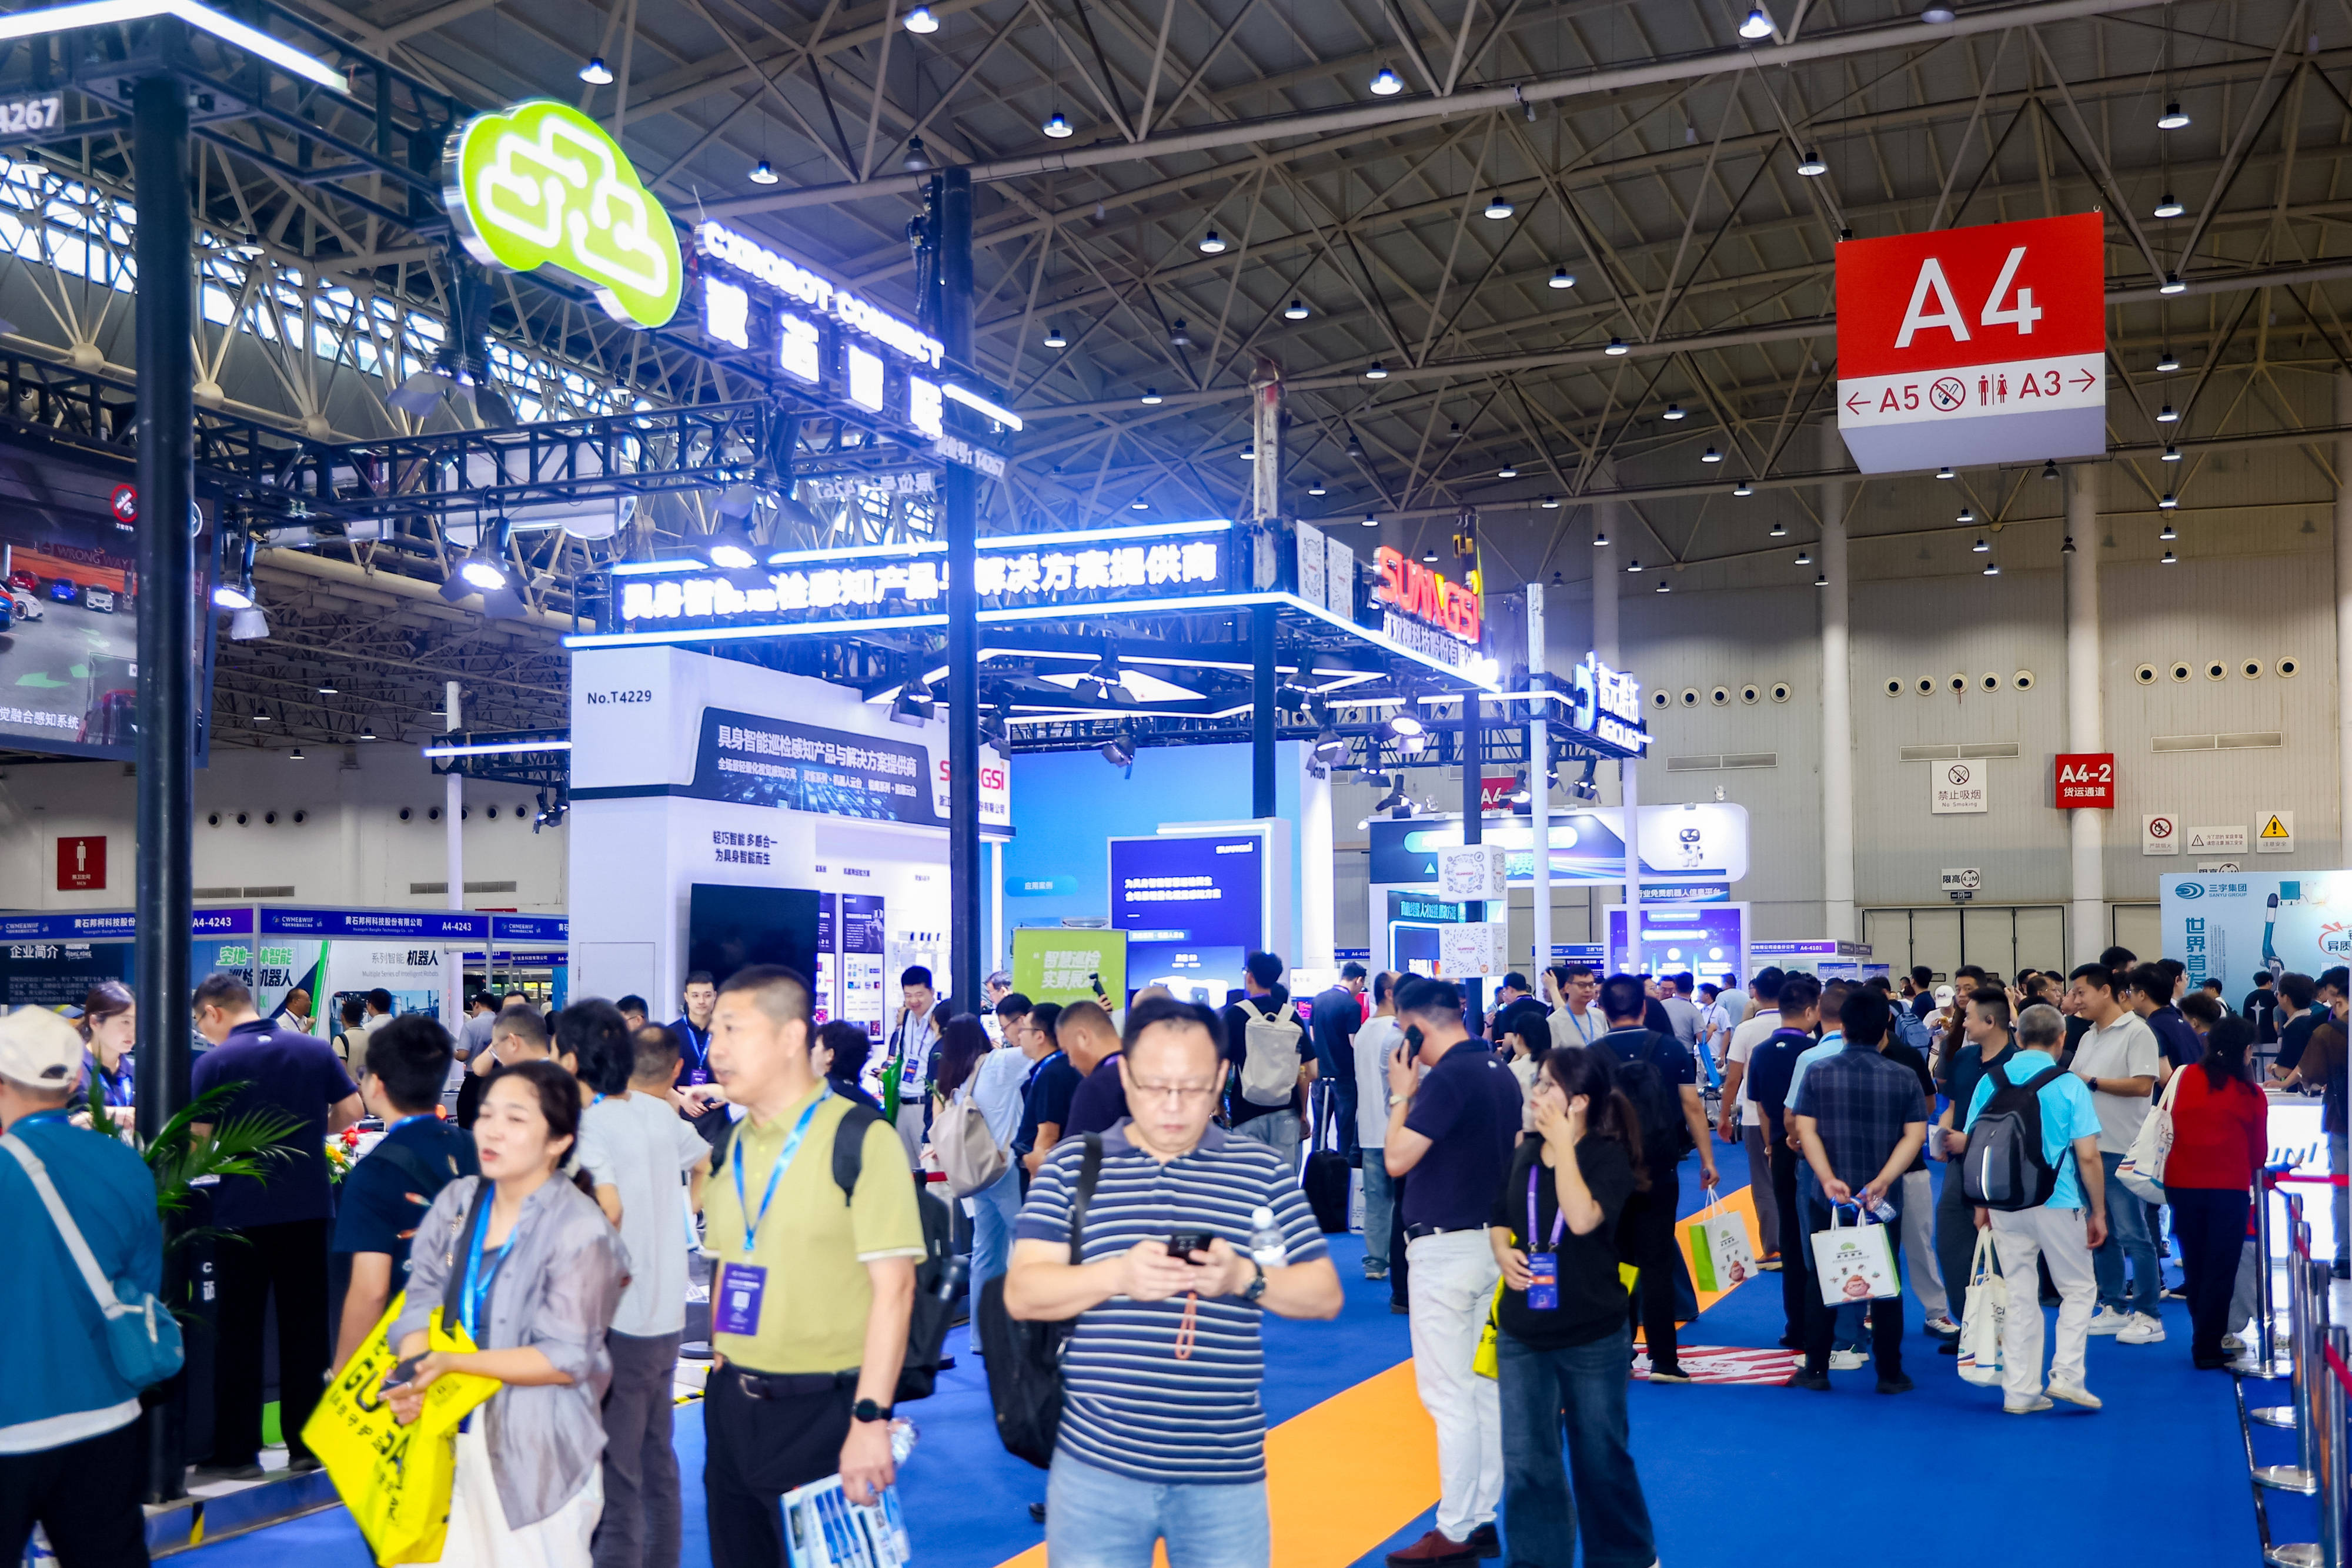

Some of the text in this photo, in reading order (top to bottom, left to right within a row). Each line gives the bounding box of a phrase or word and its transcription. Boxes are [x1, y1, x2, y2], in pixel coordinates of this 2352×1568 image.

[1894, 246, 2042, 349] A4
[2019, 370, 2061, 399] A3
[1879, 385, 1919, 413] A5
[57, 546, 100, 564] WRONG
[588, 690, 652, 704] No.T4229
[718, 724, 917, 778] 具身智能巡检感知产品与解决方案提供商
[2059, 764, 2111, 783] A4-2
[1937, 790, 1981, 801] 禁止吸烟
[2063, 787, 2106, 797] 货运通道
[713, 831, 746, 847] 轻巧智能
[716, 848, 771, 865] 为具身智能而生
[1943, 874, 1960, 884] 限高
[2208, 883, 2247, 892] 三宇集团
[192, 917, 232, 927] A4-4243
[345, 915, 422, 927] 黄石邦柯科技股份有限公司
[442, 922, 472, 931] A4-4243
[10, 944, 59, 959] 企业简介
[372, 950, 439, 966] 系列智能 机器人
[2185, 917, 2206, 989] 世界首发
[1044, 951, 1101, 969] 智慧巡检
